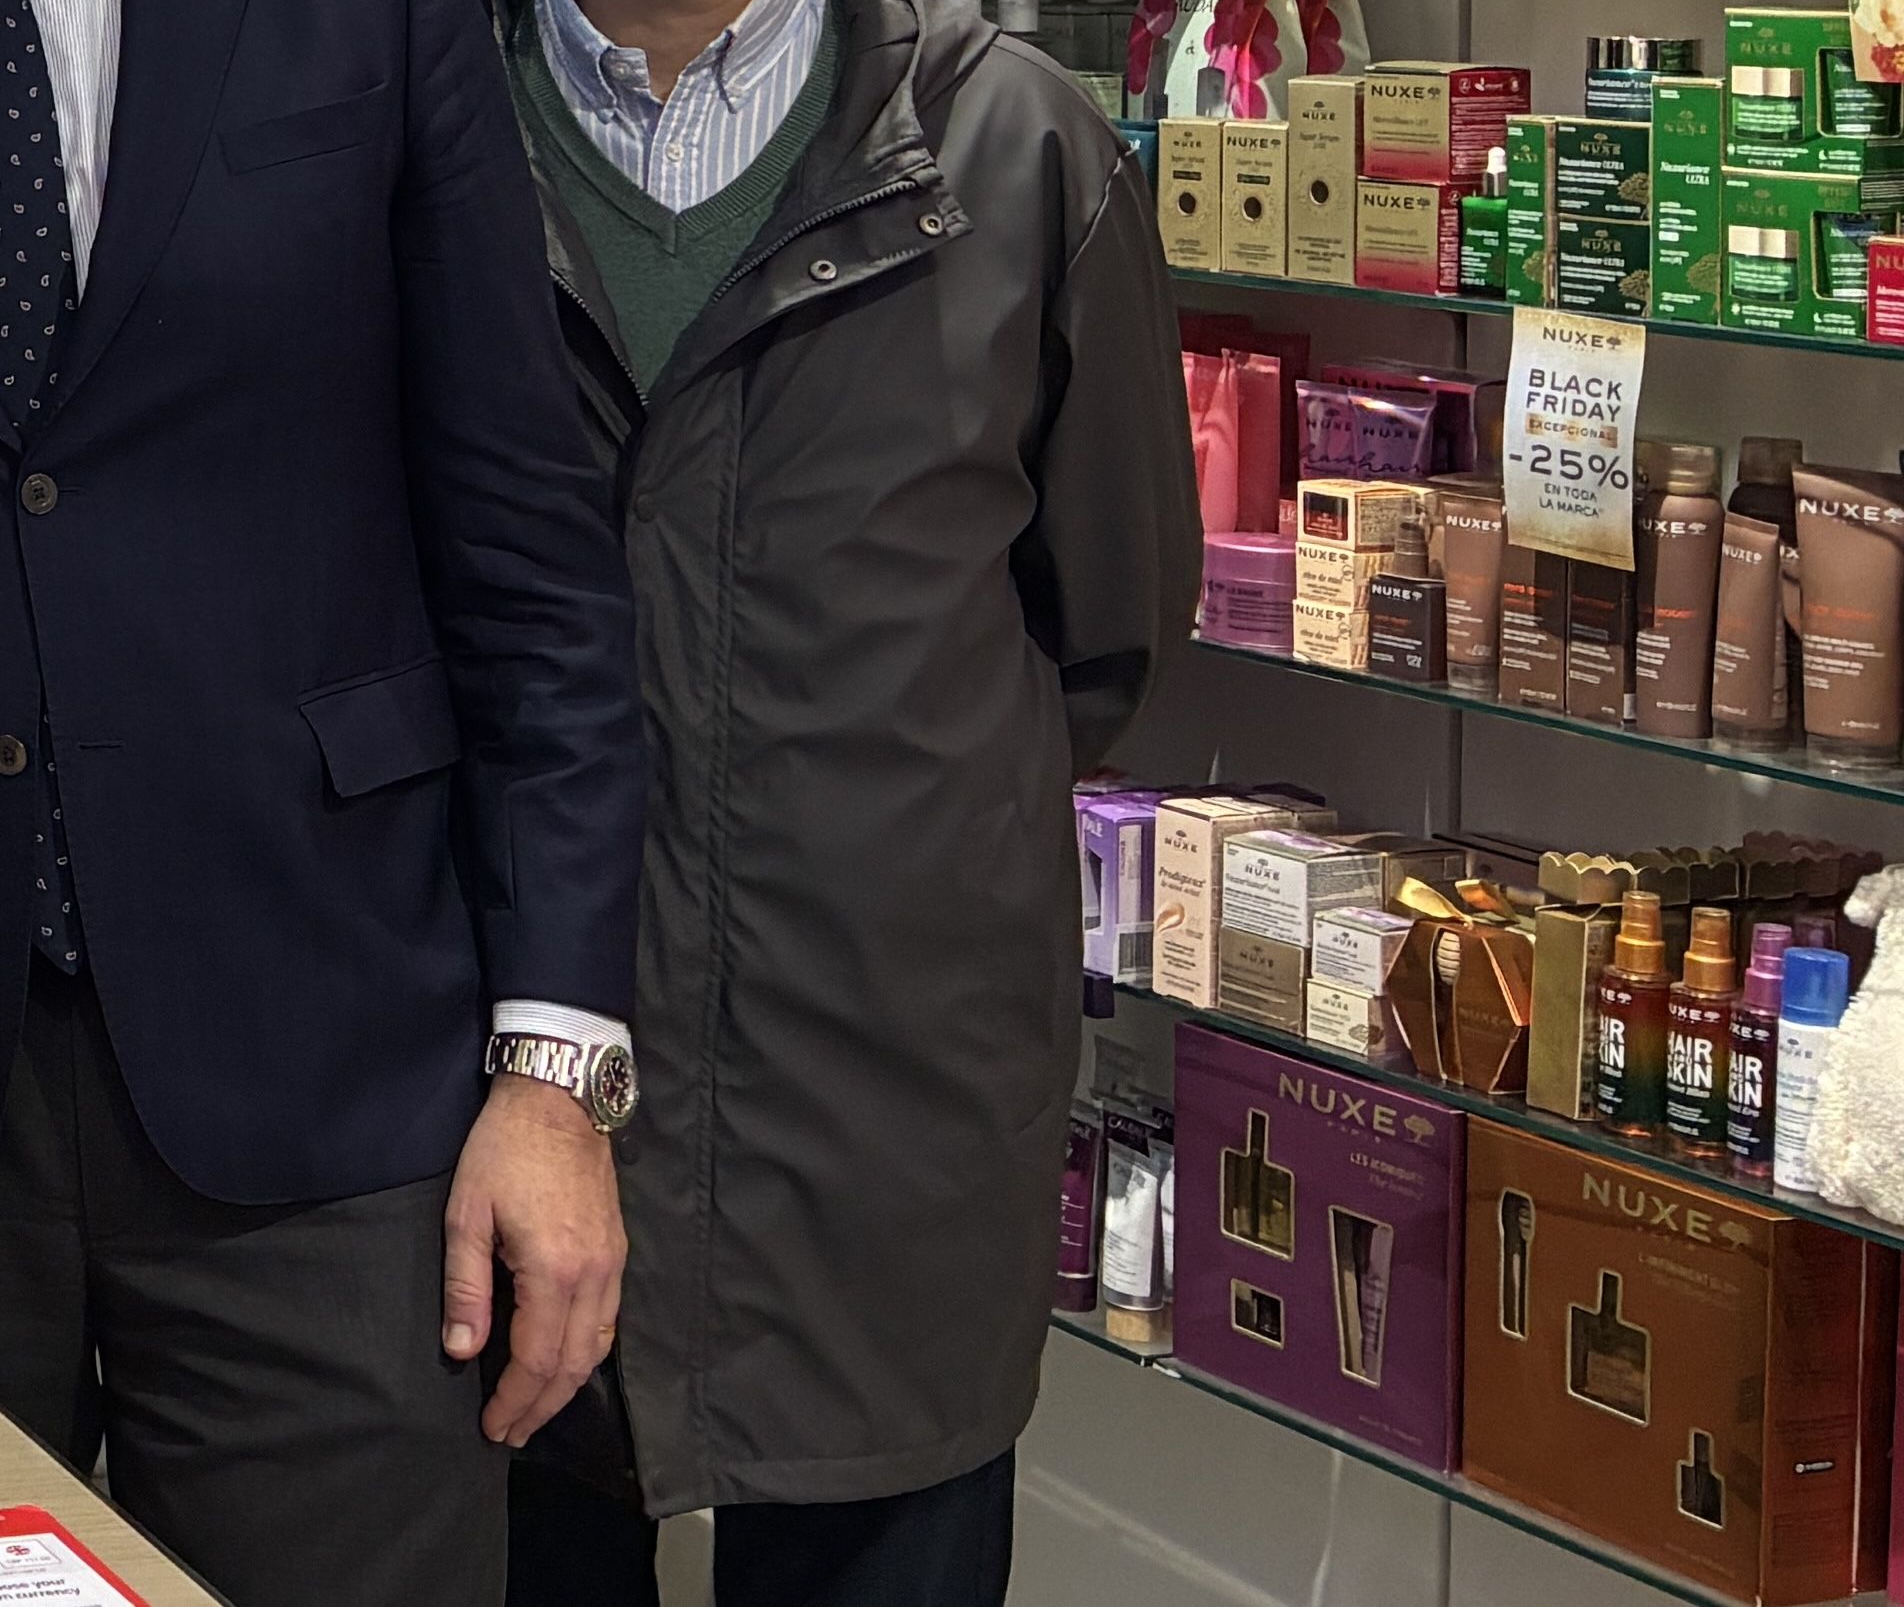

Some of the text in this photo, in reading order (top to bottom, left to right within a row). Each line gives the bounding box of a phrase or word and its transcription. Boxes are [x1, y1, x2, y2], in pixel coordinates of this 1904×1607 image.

[1371, 84, 1425, 99] NUXE
[1227, 136, 1269, 149] NUXE
[1363, 193, 1415, 210] NUXE
[1543, 326, 1604, 349] NUXE
[1528, 367, 1623, 401] BLACK
[1526, 391, 1621, 422] FRIDAY
[1509, 444, 1629, 490] -25%
[1544, 482, 1598, 502] EN TODA
[1539, 499, 1555, 510] LA
[1799, 498, 1882, 522] NUXE
[1446, 515, 1492, 532] NUXE
[1298, 546, 1339, 563] NUXE
[1372, 584, 1411, 600] NUXE
[1295, 603, 1335, 621] NUXE
[1279, 1073, 1398, 1136] NUXE
[1582, 1171, 1715, 1245] NUXE
[32, 1578, 66, 1592] your
[15, 1586, 81, 1603] currency
